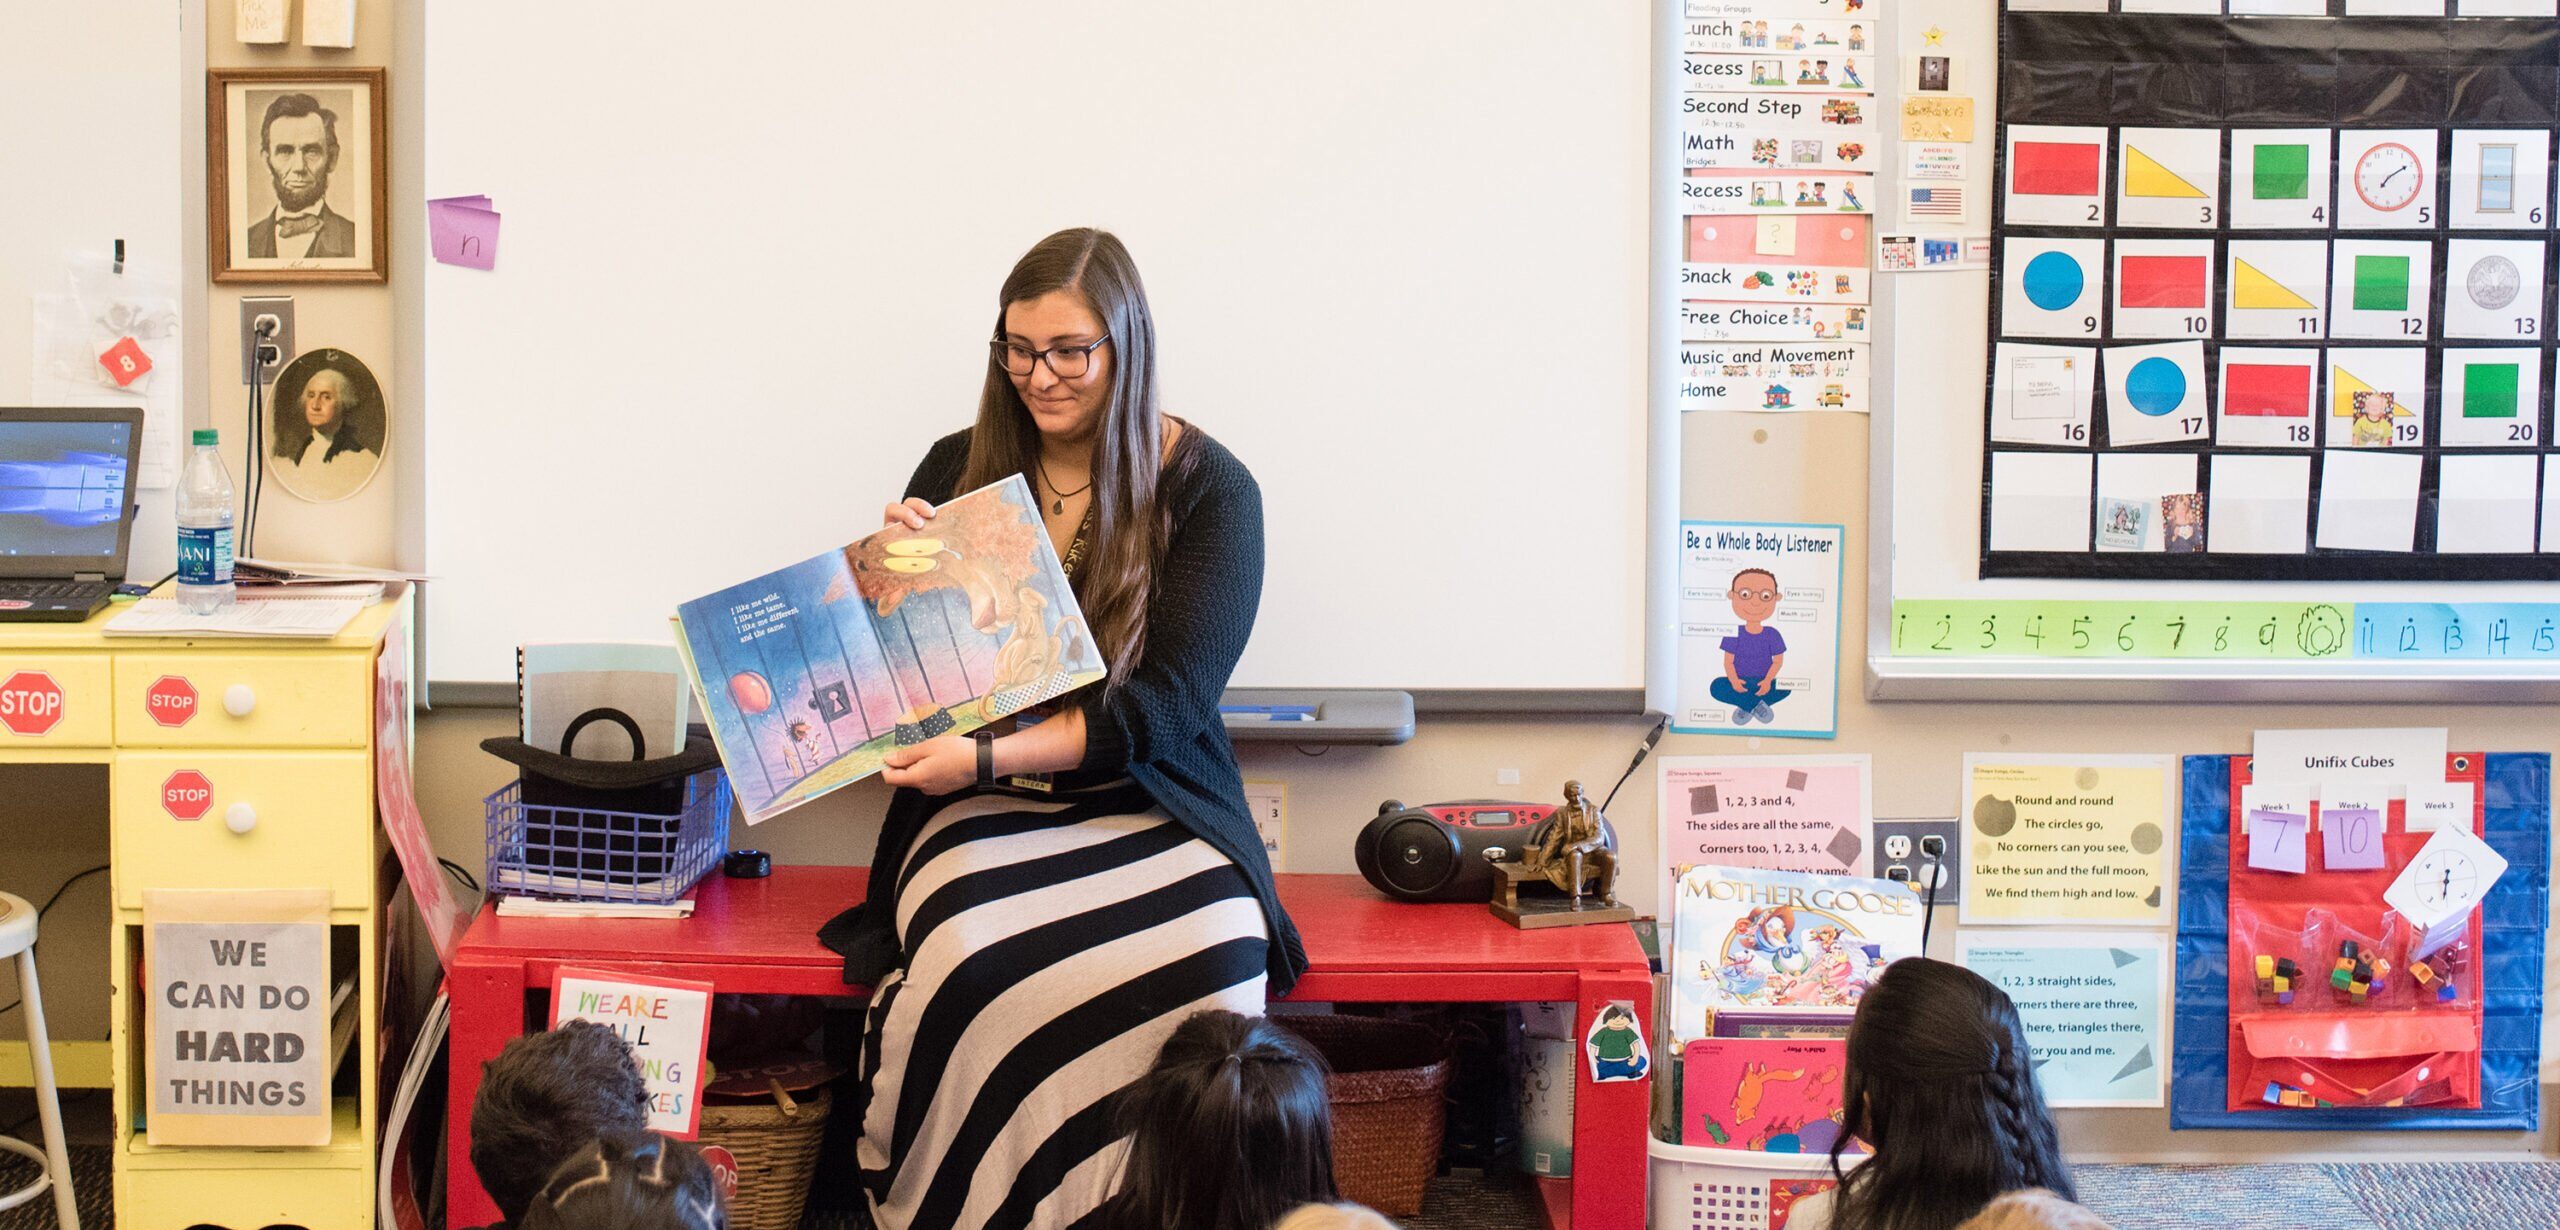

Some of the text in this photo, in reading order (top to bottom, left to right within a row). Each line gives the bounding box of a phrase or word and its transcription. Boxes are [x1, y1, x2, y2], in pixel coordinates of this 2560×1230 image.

[1724, 4, 1752, 14] Groups
[1684, 20, 1732, 37] unch
[1683, 98, 1801, 119] Second Step
[1687, 134, 1734, 150] Math
[1686, 157, 1717, 168] Bridges
[1683, 182, 1743, 198] Recess
[2086, 204, 2099, 221] 2
[2200, 206, 2212, 223] 3
[2312, 206, 2325, 223] 4
[2418, 207, 2431, 223] 5
[2529, 207, 2542, 224] 6
[461, 234, 480, 257] n
[1730, 309, 1788, 325] Choice
[2083, 316, 2097, 333] 9
[2184, 316, 2207, 333] 10
[2298, 317, 2317, 334] 11
[2401, 318, 2422, 335] 12
[2514, 317, 2536, 334] 13
[120, 355, 136, 372] 8
[1681, 347, 1855, 364] Music and Movement
[1681, 382, 1727, 398] Home
[2062, 424, 2085, 441] 16
[2180, 417, 2203, 435] 17
[2287, 425, 2310, 442] 18
[2396, 424, 2418, 441] 19
[2508, 424, 2533, 441] 20
[1687, 530, 1833, 556] Be a Whole Body Listener
[735, 604, 750, 614] like
[751, 600, 762, 608] me
[738, 613, 753, 623] like
[754, 609, 765, 617] me
[741, 622, 756, 632] like
[757, 618, 768, 626] me
[740, 632, 753, 643] and
[753, 629, 766, 639] the
[1898, 618, 2555, 655] 1 2 3 4 5 6 7 8 9 10 11 12 13 14 15
[1, 690, 61, 717] STOP
[152, 694, 194, 710] STOP
[2305, 756, 2394, 768] Unifix Cubes
[167, 788, 209, 802] STOP
[1726, 796, 1794, 807] 1, 2, 3 and 4,
[2015, 796, 2113, 805] Round and round
[2261, 803, 2284, 811] Week
[2339, 801, 2361, 809] Week
[1686, 819, 1834, 830] The sides are all the same,
[2025, 819, 2103, 831] The circles go,
[2262, 818, 2288, 853] 7
[2340, 816, 2369, 854] 10
[1700, 843, 1820, 854] Corners too, 1, 2, 3, 4,
[1998, 842, 2129, 854] No corners can you see,
[1816, 868, 1852, 877] name.
[1977, 865, 1999, 874] Like
[2002, 865, 2020, 875] the
[2047, 866, 2067, 875] and
[2071, 866, 2088, 875] the
[2092, 866, 2109, 875] full
[2113, 868, 2148, 876] moon,
[1685, 877, 1913, 917] MOTHER GOOSE
[1986, 888, 2138, 900] We find them high and low.
[210, 939, 267, 967] WE
[2003, 976, 2115, 988] 1, 2, 3 straight sides,
[166, 980, 310, 1011] CAN DO
[2051, 999, 2080, 1009] there
[2105, 999, 2137, 1010] three,
[2026, 1022, 2143, 1034] here, triangles there,
[176, 1030, 305, 1063] HARD
[2047, 1048, 2067, 1058] you
[2070, 1046, 2091, 1055] and
[170, 1079, 306, 1107] THINGS
